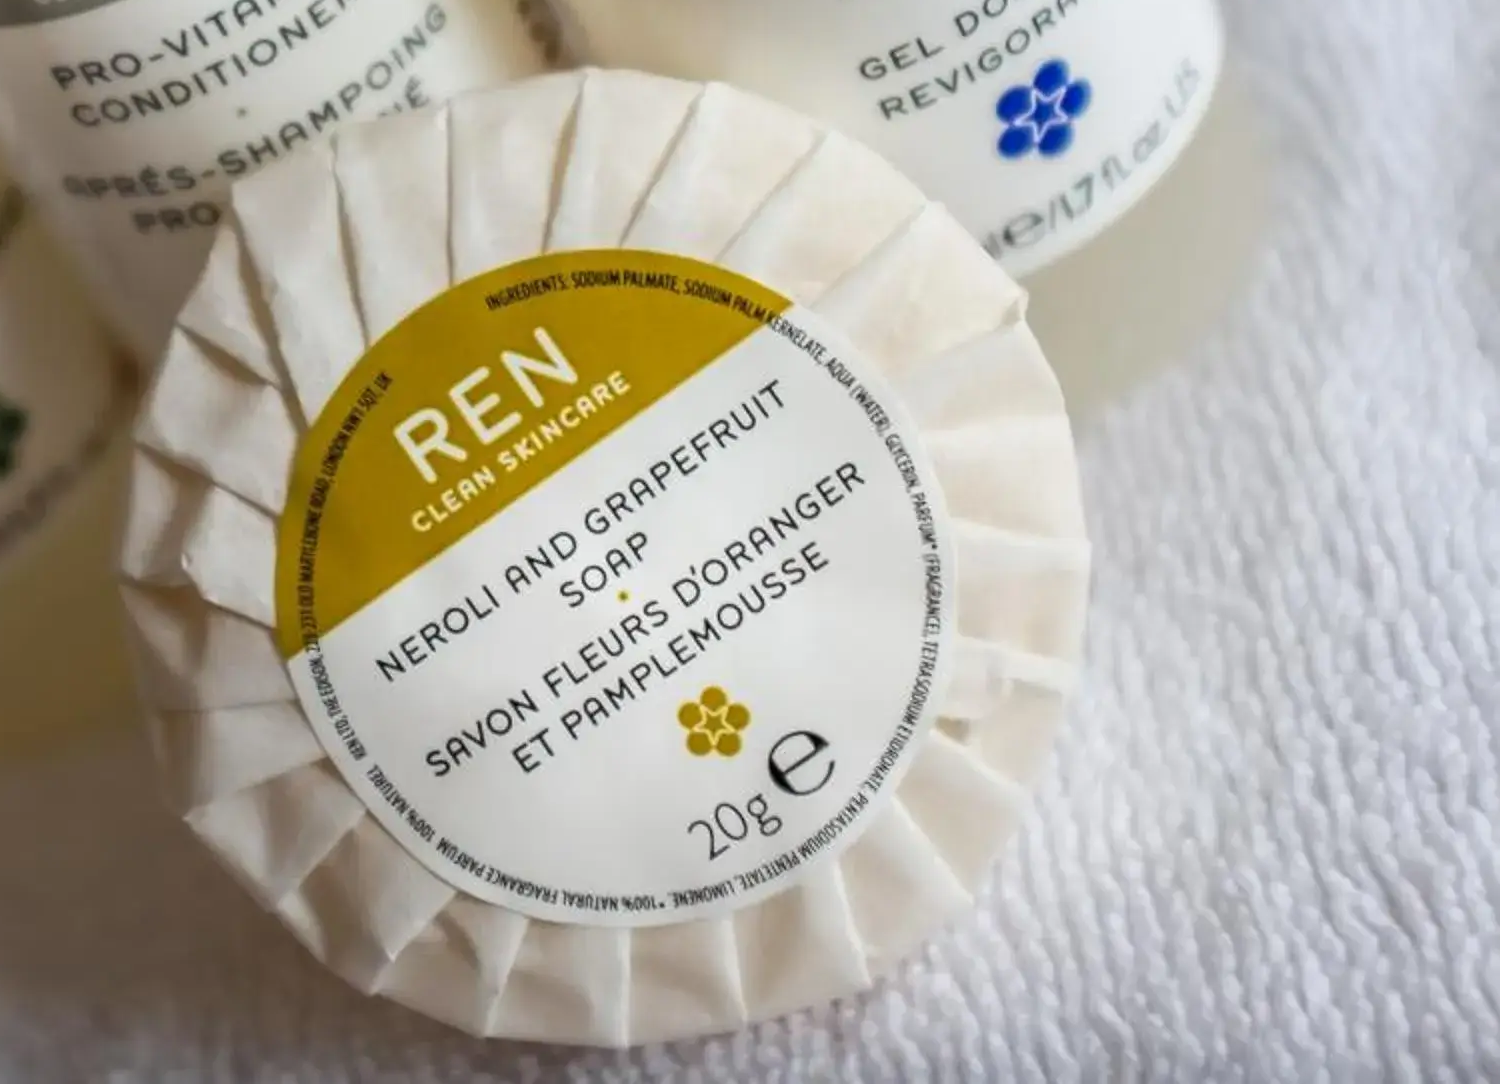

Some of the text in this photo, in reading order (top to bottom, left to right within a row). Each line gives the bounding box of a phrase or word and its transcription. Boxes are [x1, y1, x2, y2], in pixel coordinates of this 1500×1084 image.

[858, 36, 945, 81] GEL
[570, 269, 620, 289] SODIUM
[622, 269, 683, 294] PALMATE,
[681, 276, 734, 307] SODIUM
[822, 354, 858, 390] AQUA
[393, 326, 578, 484] REN
[411, 370, 631, 533] CLEAN SKINCARE
[375, 379, 791, 684] NEROLI AND GRAPEFRUIT
[559, 529, 650, 609] SOAP
[426, 460, 867, 778] SAVON FLEURS D'ORANGER
[511, 540, 831, 775] ET PAMPLEMOUSSE
[900, 640, 940, 727] TETRASODIUM
[364, 763, 411, 816] NATUREL
[402, 807, 437, 843] 100%
[687, 793, 783, 861] 20g
[795, 790, 871, 861] PENTASODIUM
[433, 836, 487, 879] PARFUM
[483, 866, 558, 905] FRAGRANCE
[559, 889, 618, 911] NATURAL
